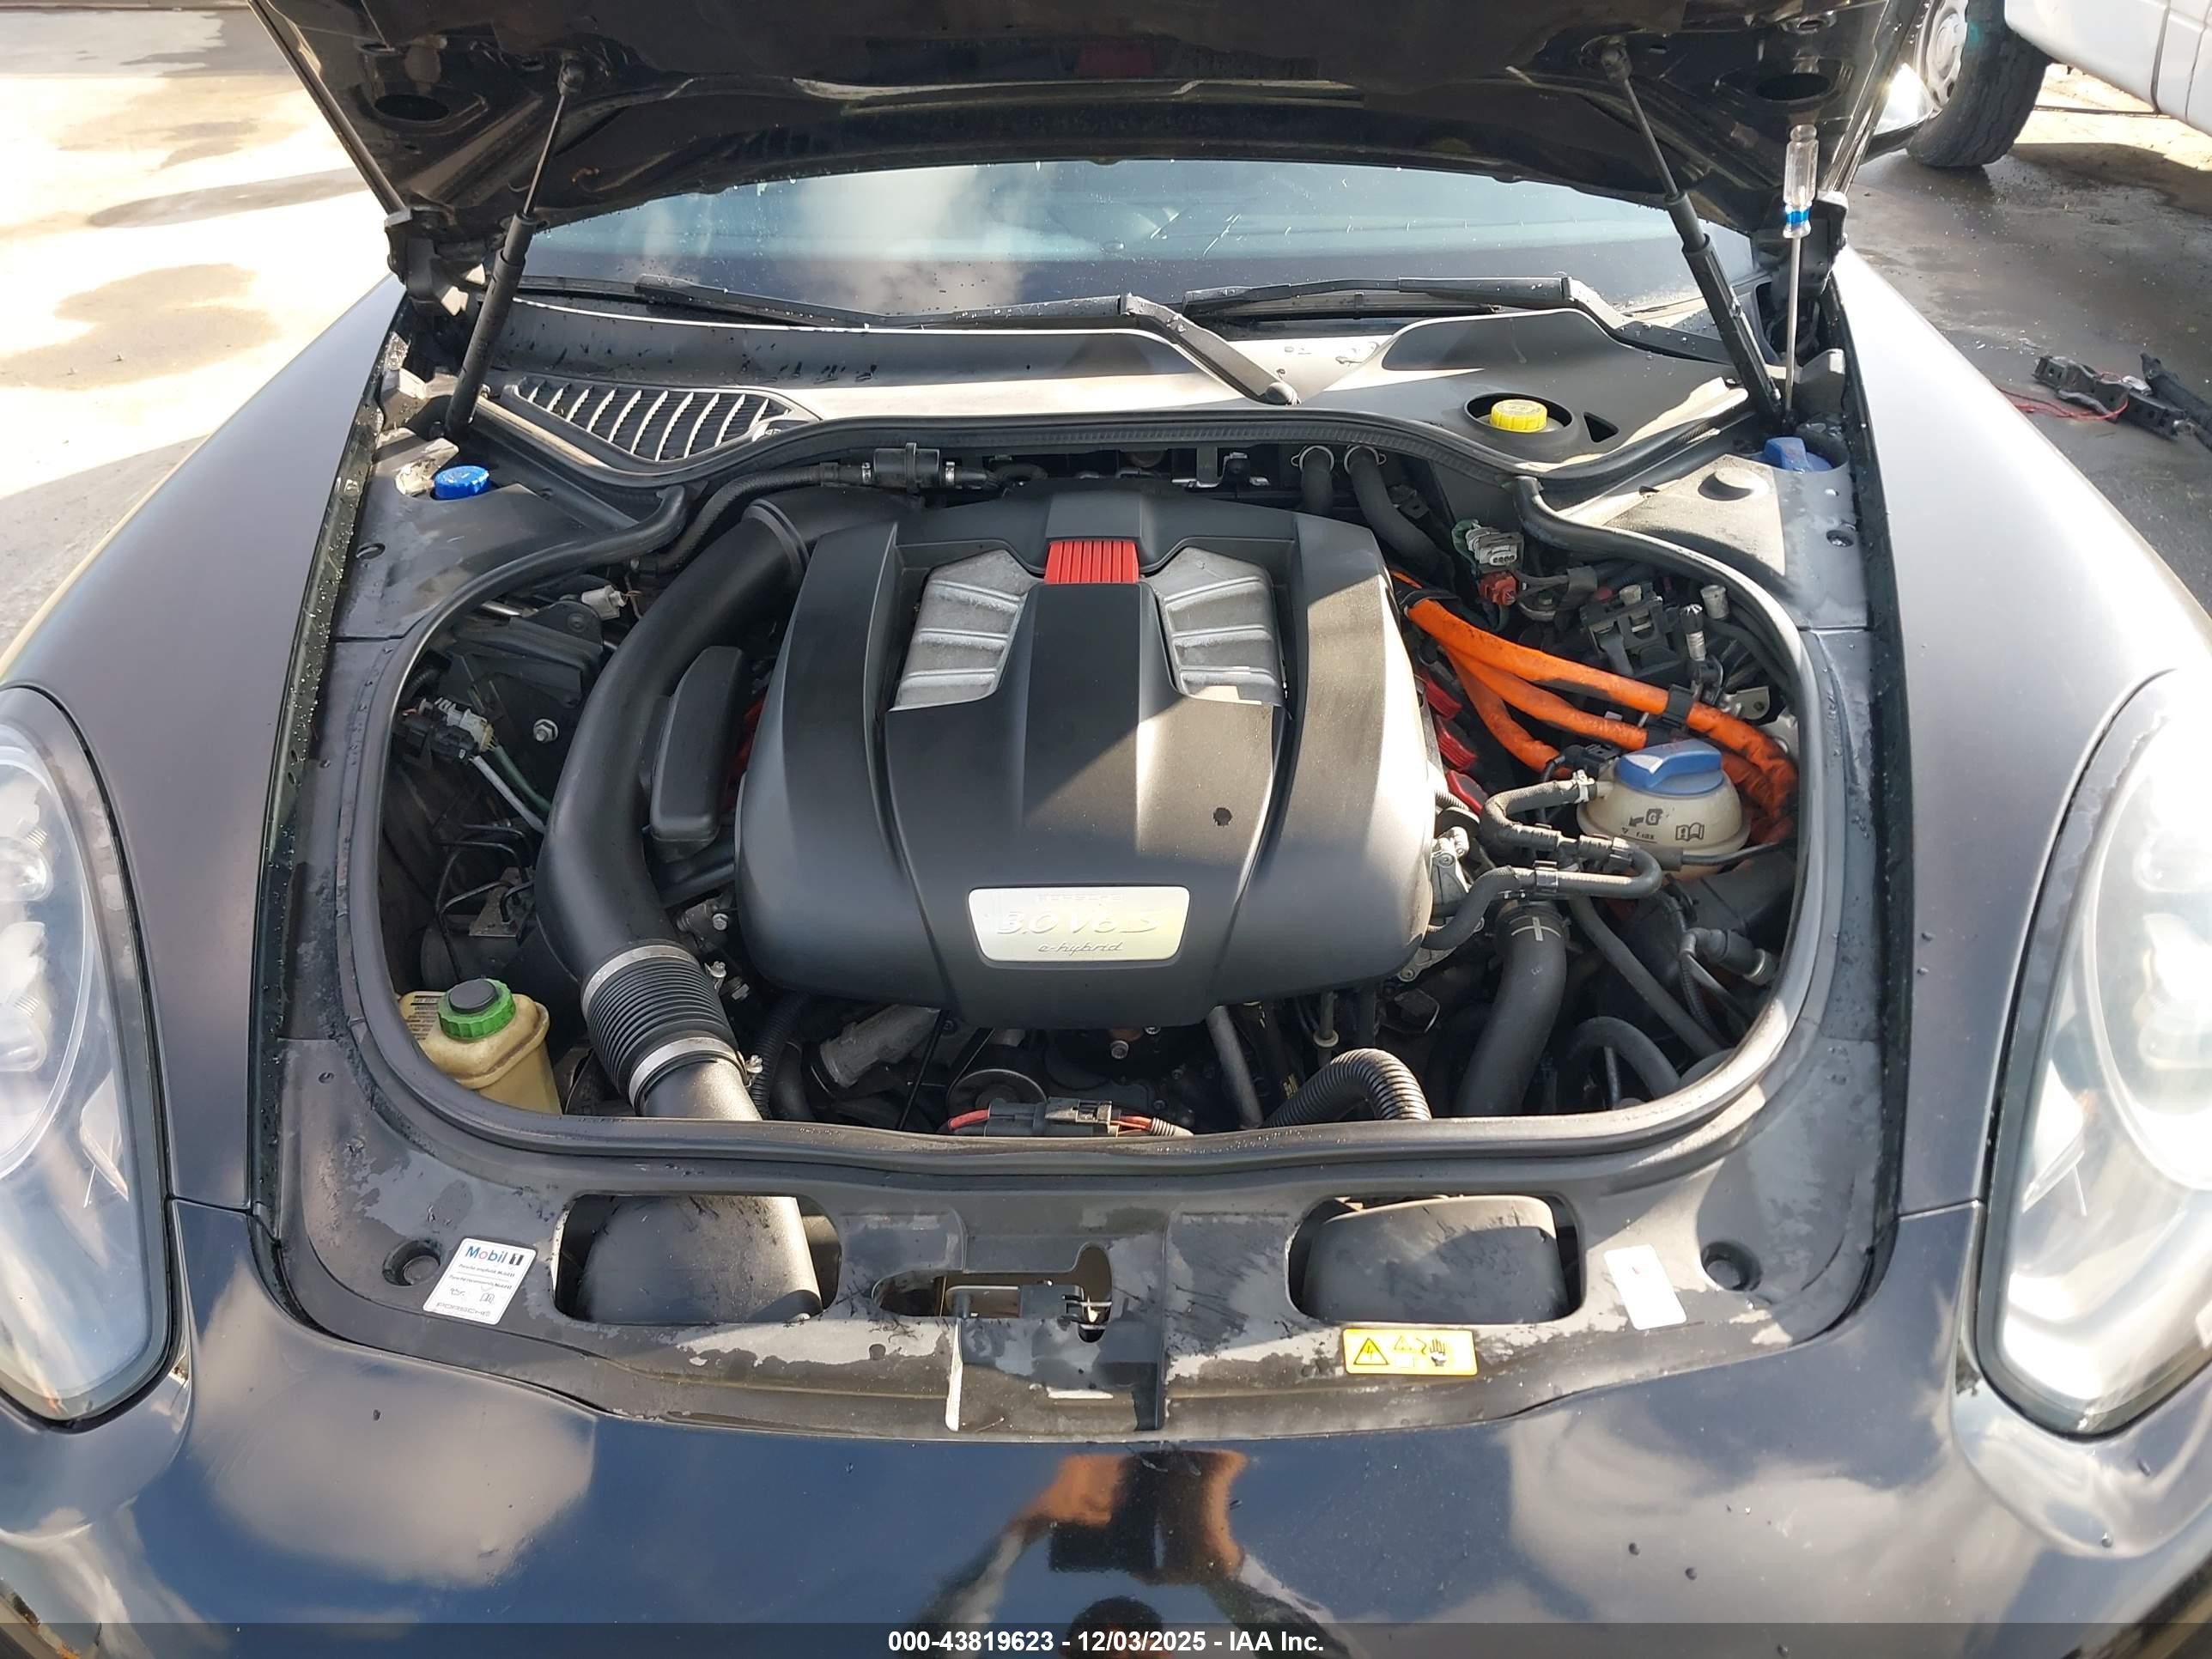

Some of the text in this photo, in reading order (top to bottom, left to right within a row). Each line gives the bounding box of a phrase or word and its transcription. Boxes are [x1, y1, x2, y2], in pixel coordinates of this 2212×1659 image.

[1037, 941, 1123, 956] e-hybrid
[465, 1245, 525, 1266] Mobil 1
